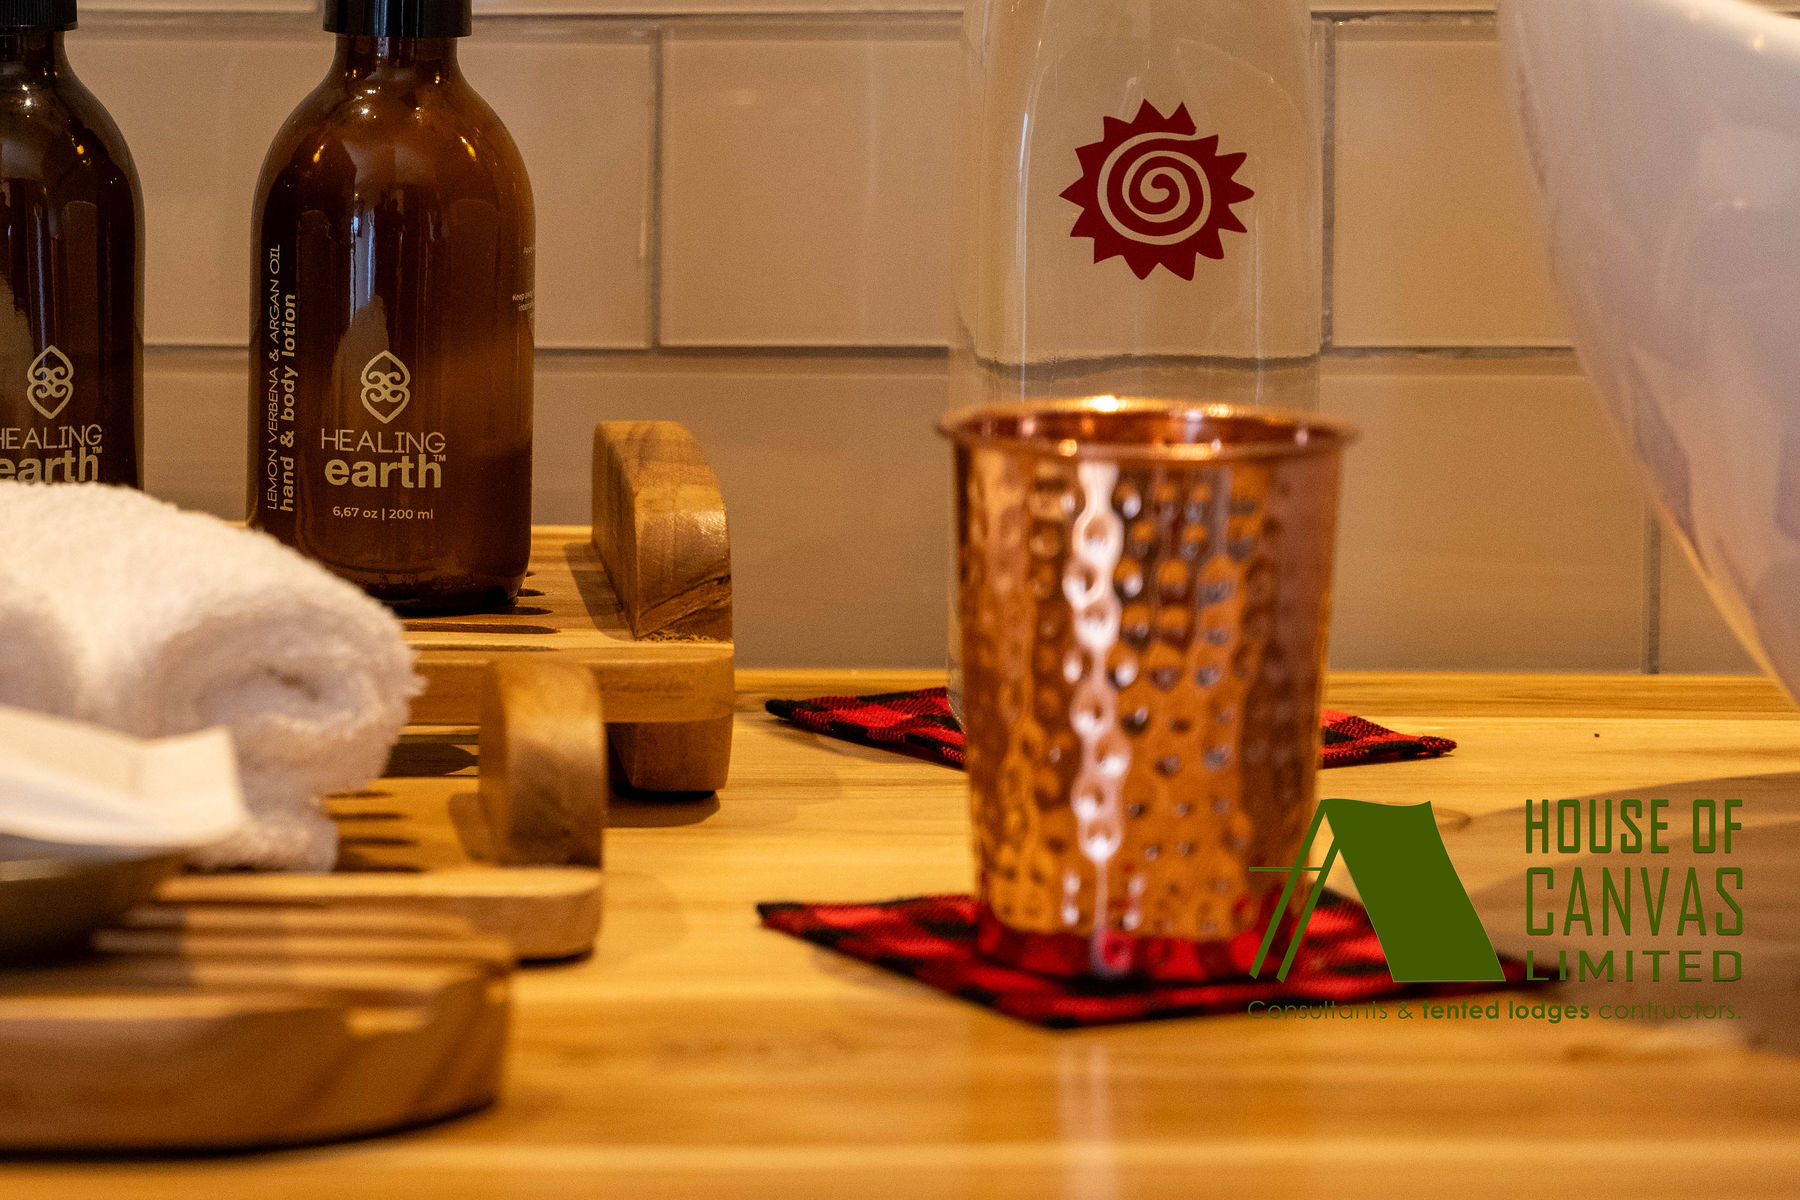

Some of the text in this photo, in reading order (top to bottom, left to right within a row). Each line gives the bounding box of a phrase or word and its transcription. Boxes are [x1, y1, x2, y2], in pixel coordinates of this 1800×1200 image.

[267, 244, 281, 510] LEMON VERBENA & ARGAN OIL
[280, 294, 299, 512] hand & body lotion
[321, 428, 446, 454] HEALING
[324, 454, 442, 489] earth
[333, 506, 359, 519] 6,67
[362, 508, 378, 519] oz
[388, 508, 413, 520] 200
[417, 508, 434, 519] ml
